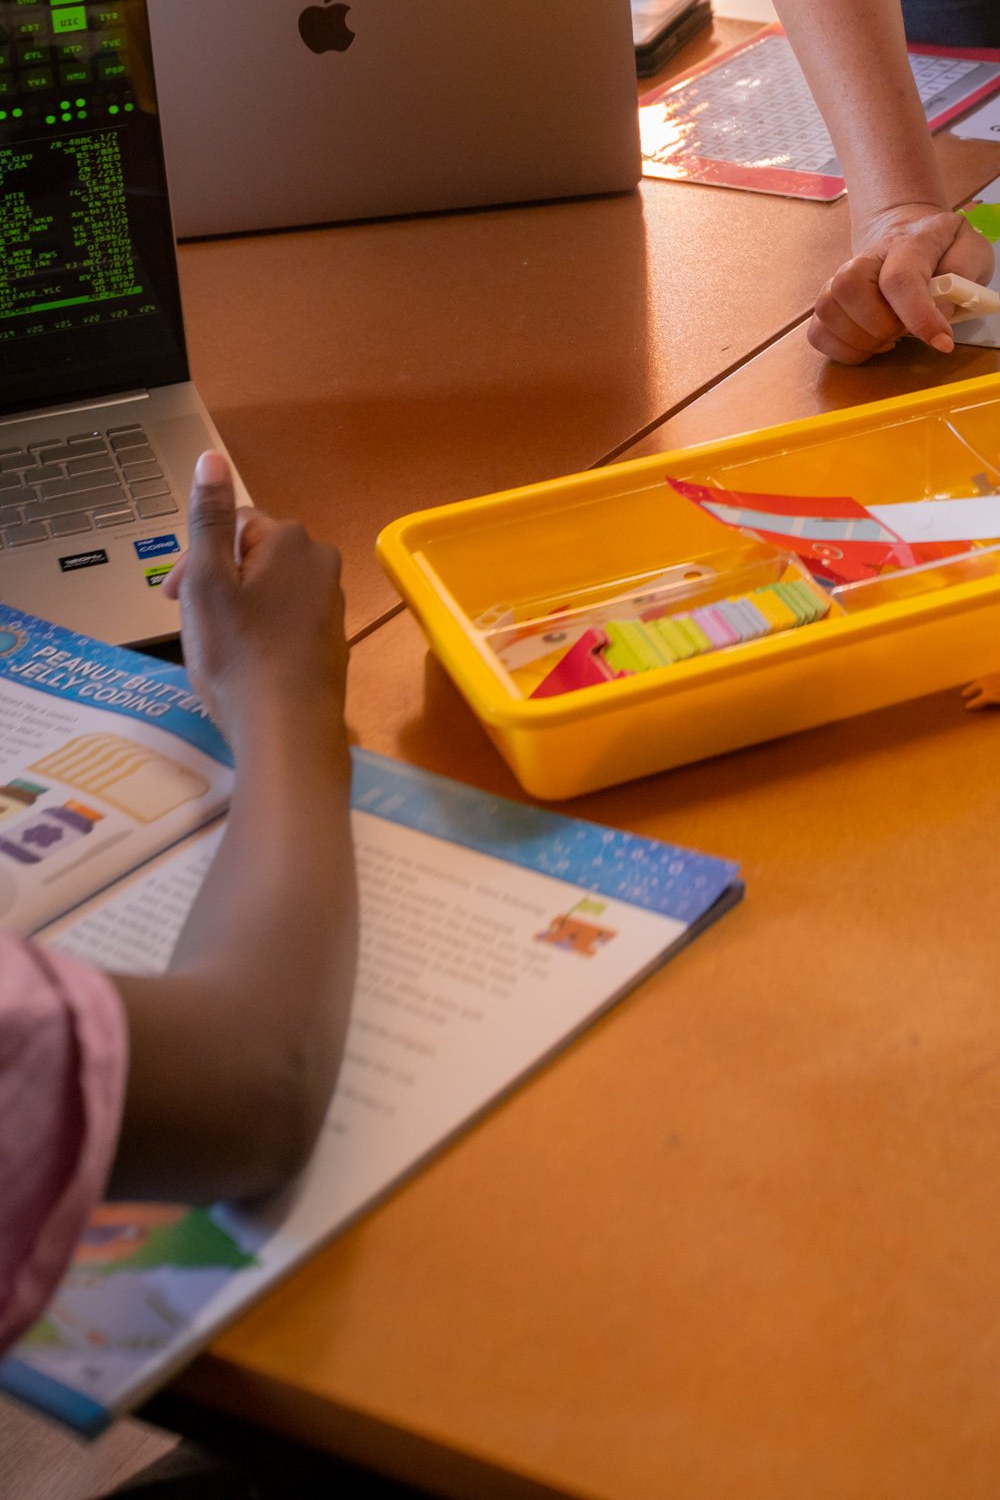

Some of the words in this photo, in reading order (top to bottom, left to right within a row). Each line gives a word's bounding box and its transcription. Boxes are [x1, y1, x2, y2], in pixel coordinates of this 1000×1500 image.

[32, 645, 128, 683] PEANUT
[10, 660, 89, 691] JELLY
[79, 681, 172, 717] CODING
